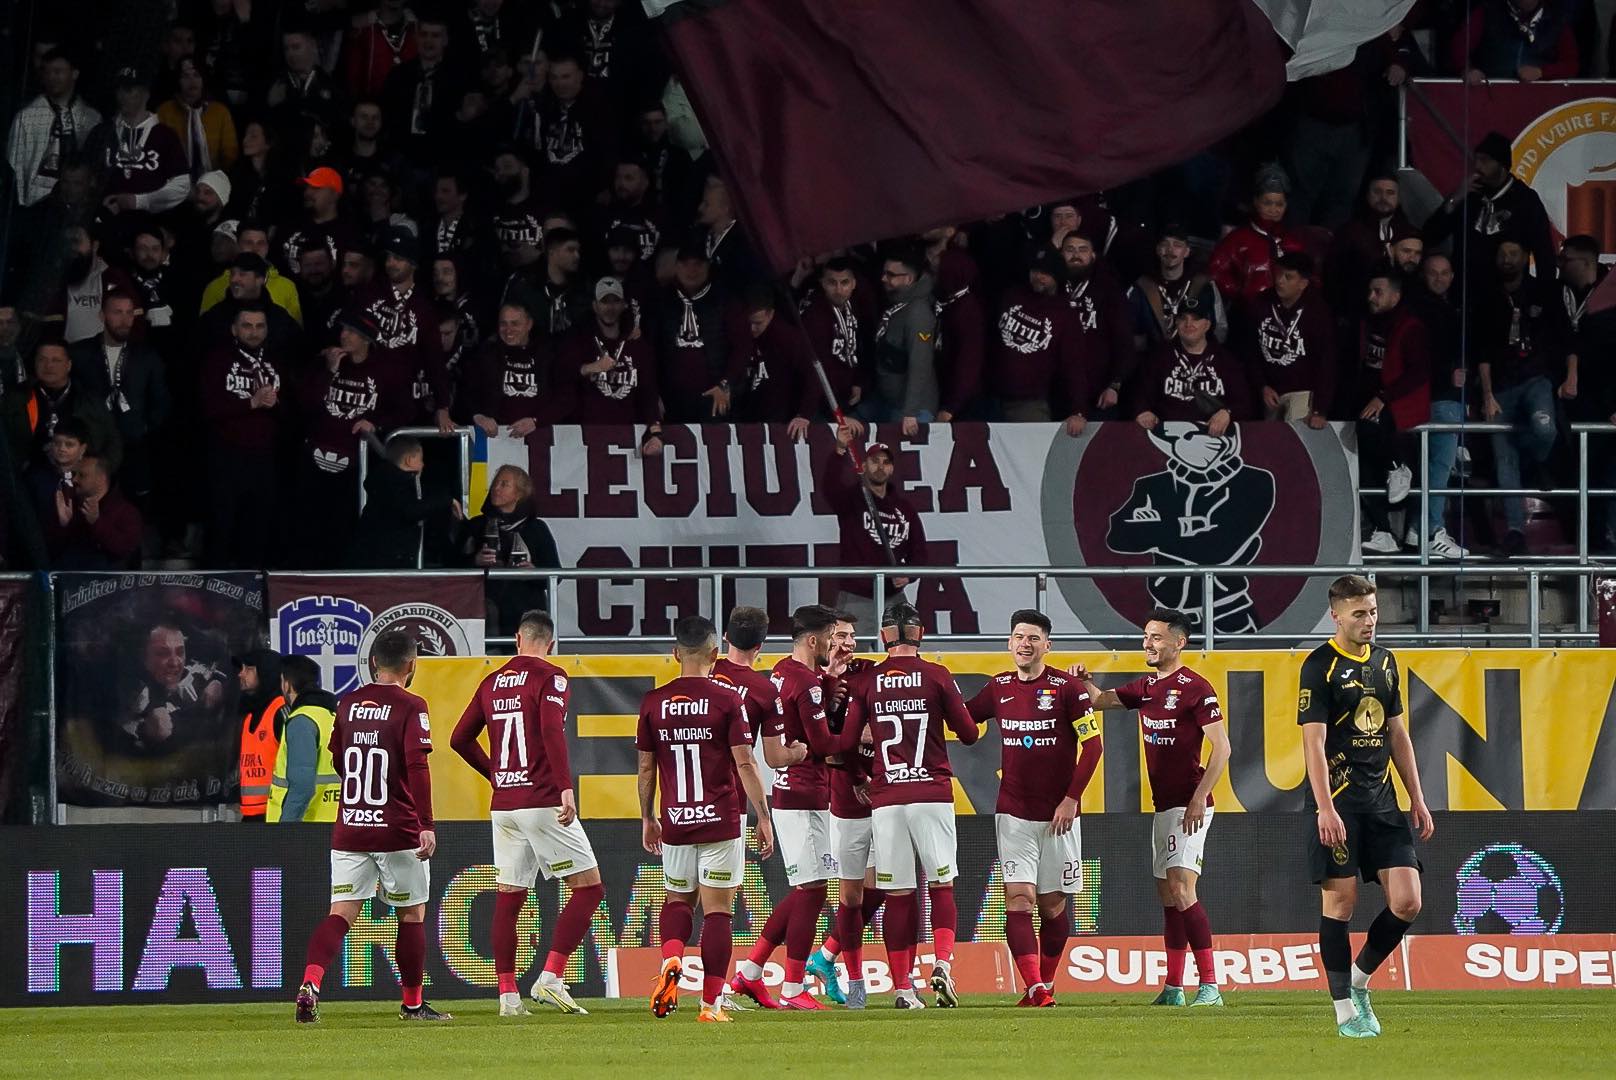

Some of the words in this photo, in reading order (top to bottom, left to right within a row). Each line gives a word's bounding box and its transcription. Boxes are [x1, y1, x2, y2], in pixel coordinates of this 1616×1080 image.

[576, 543, 979, 635] CHITIA
[492, 671, 529, 691] Ferroli
[876, 672, 922, 693] Ferroli
[348, 702, 392, 722] Ferroli
[661, 699, 709, 720] Ferroli
[875, 701, 884, 714] D.
[886, 699, 927, 713] GRIGORE
[674, 727, 713, 741] MORAIS
[1001, 718, 1057, 732] SUPERBET
[492, 711, 528, 769] 71
[876, 713, 929, 772] 27
[1034, 737, 1057, 746] CITY
[1156, 737, 1176, 746] CITY
[343, 746, 390, 806] 80
[505, 770, 529, 783] DSC
[670, 744, 704, 803] 11
[899, 767, 930, 780] DSC
[354, 808, 384, 823] DSC
[684, 804, 716, 820] DSC
[1167, 834, 1177, 852] 8
[1063, 860, 1080, 879] 22
[27, 867, 283, 992] HAI
[1067, 942, 1321, 985] SUPRBE
